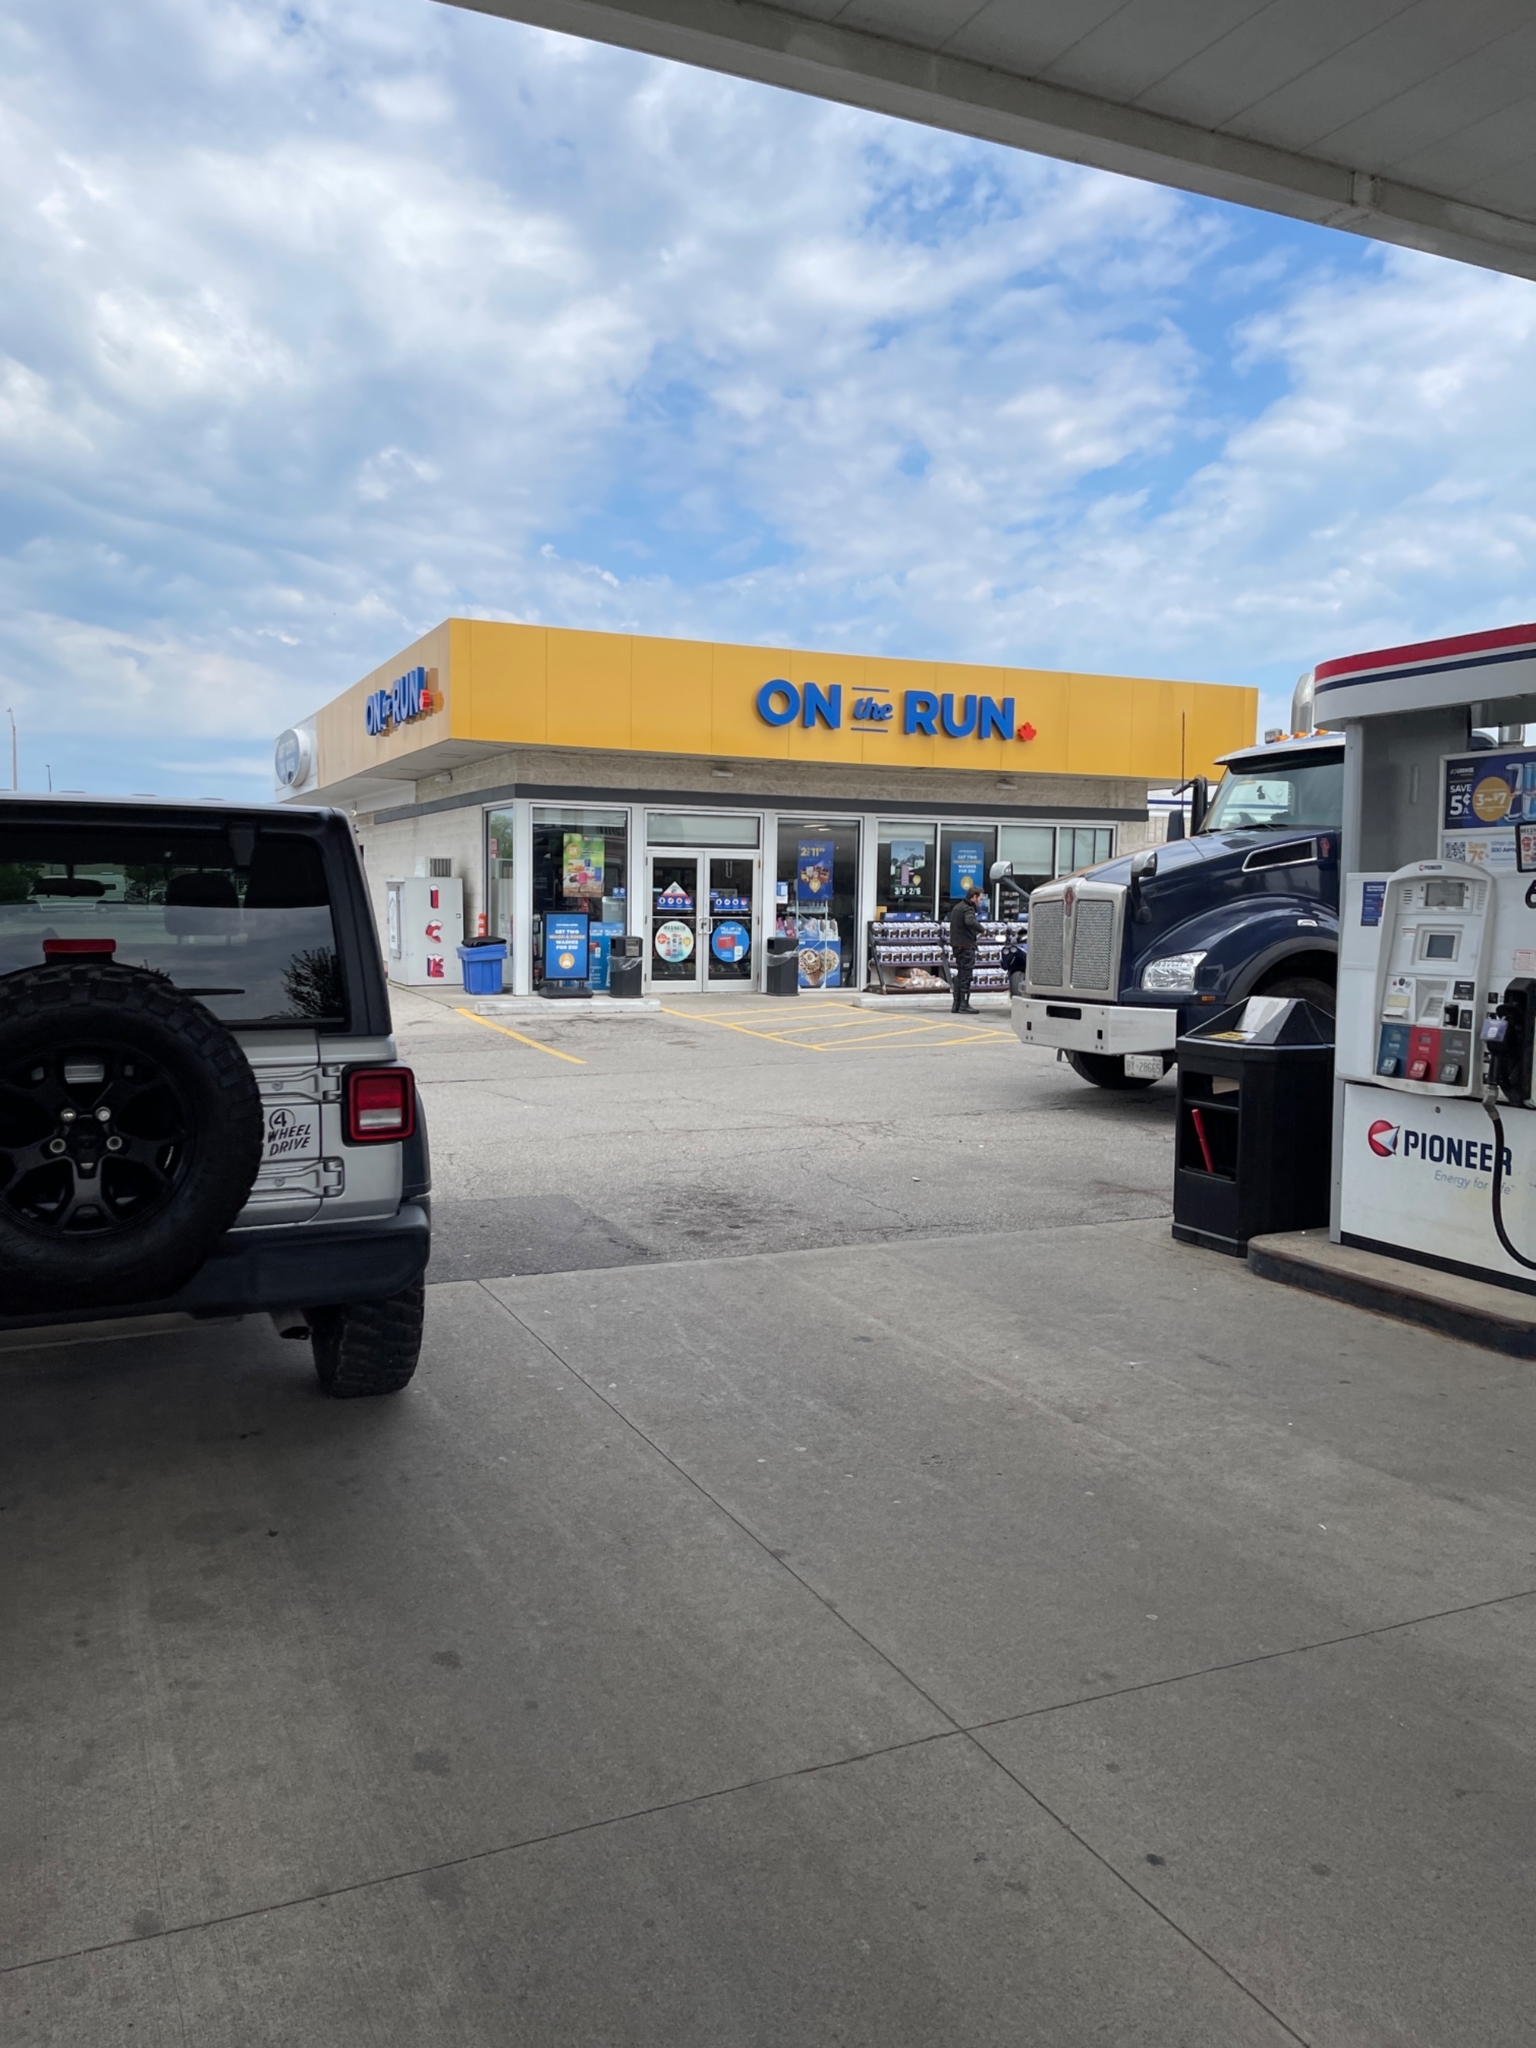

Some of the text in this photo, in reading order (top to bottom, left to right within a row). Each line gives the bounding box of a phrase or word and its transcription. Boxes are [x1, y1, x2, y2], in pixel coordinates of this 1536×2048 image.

[366, 690, 386, 736] ON
[393, 667, 425, 723] RUN
[757, 679, 1015, 740] ON the RUN
[1450, 784, 1472, 793] SAVE
[1476, 794, 1485, 806] 3
[800, 847, 807, 857] 2
[426, 884, 444, 978] ICE
[274, 1111, 287, 1127] 4
[268, 1124, 311, 1143] WHEEL
[270, 1137, 311, 1156] DRIVE
[1404, 1129, 1512, 1176] PIONEER
[1434, 1170, 1470, 1189] Energy
[1474, 1177, 1489, 1190] for
